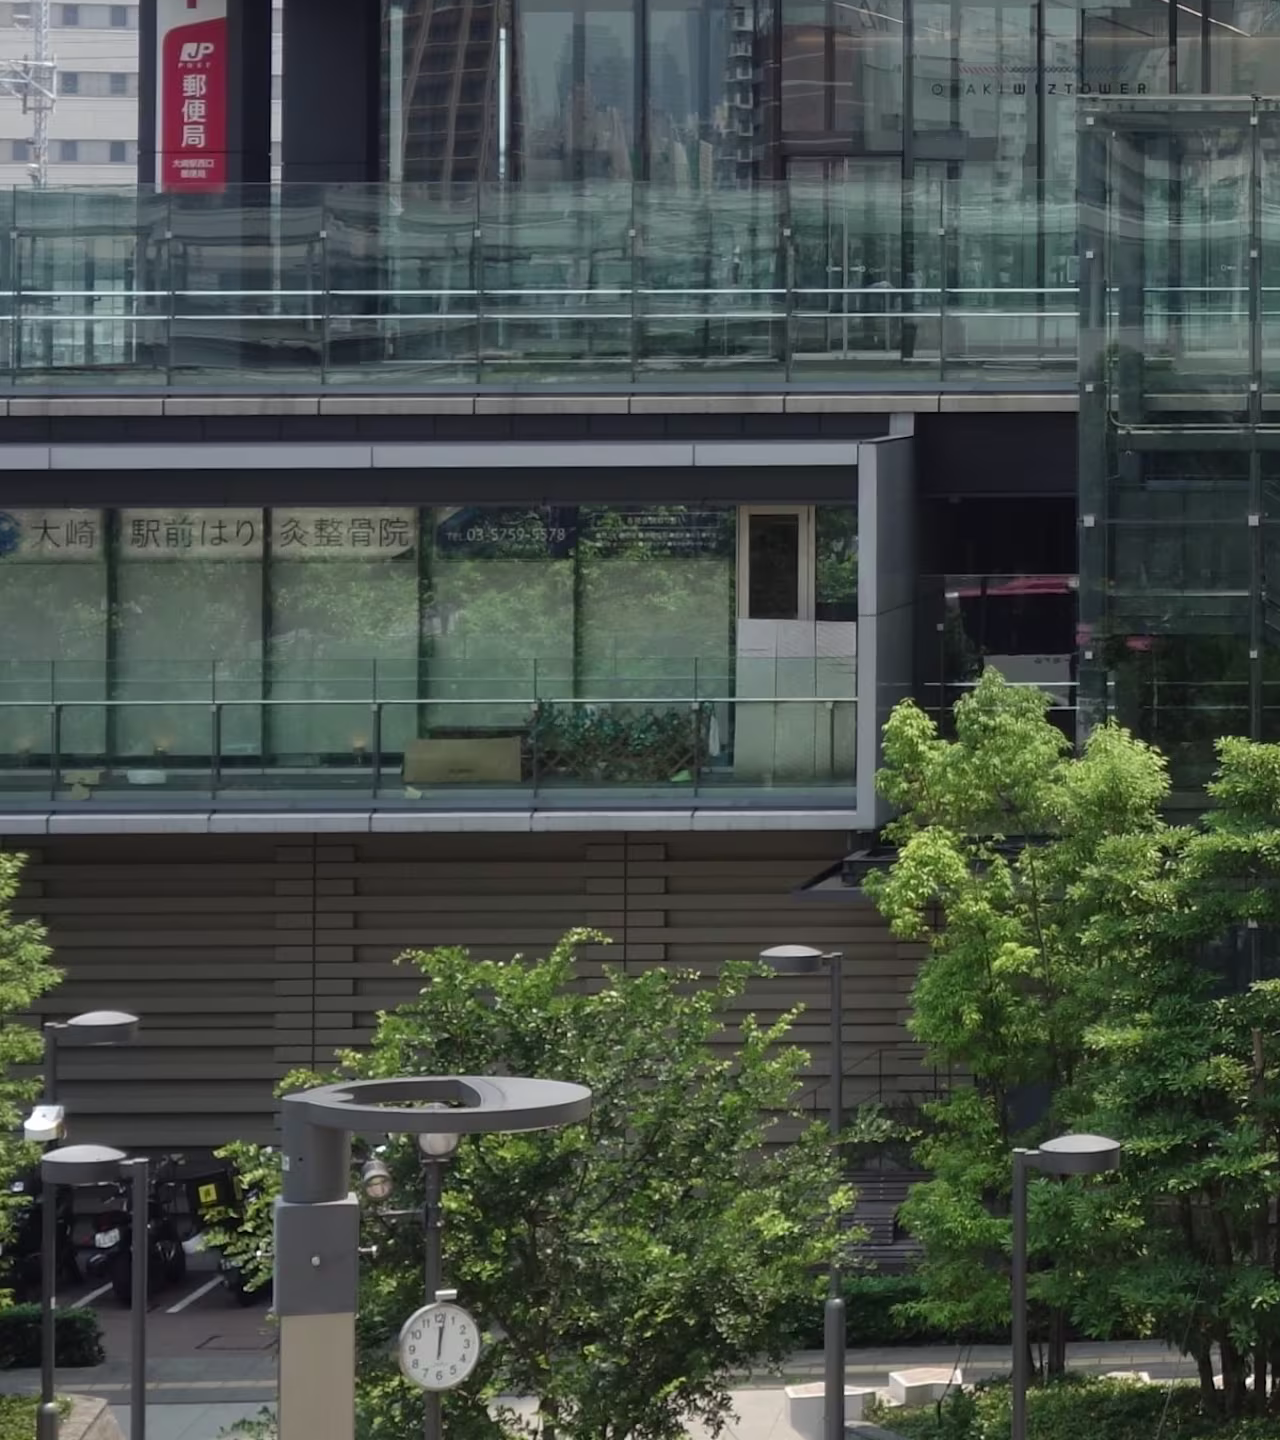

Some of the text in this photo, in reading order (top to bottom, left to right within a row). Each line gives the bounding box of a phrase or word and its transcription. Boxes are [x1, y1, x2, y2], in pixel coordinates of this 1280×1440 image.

[179, 42, 215, 61] JP
[181, 74, 207, 148] 郵便局
[422, 1319, 430, 1328] 11
[411, 1329, 422, 1340] 10
[459, 1325, 466, 1335] 2
[463, 1339, 470, 1349] 3
[408, 1345, 415, 1354] 9
[459, 1354, 466, 1363] 4
[412, 1359, 419, 1368] 8
[422, 1368, 429, 1377] 7
[450, 1365, 456, 1375] 5
[436, 1371, 443, 1380] 6
